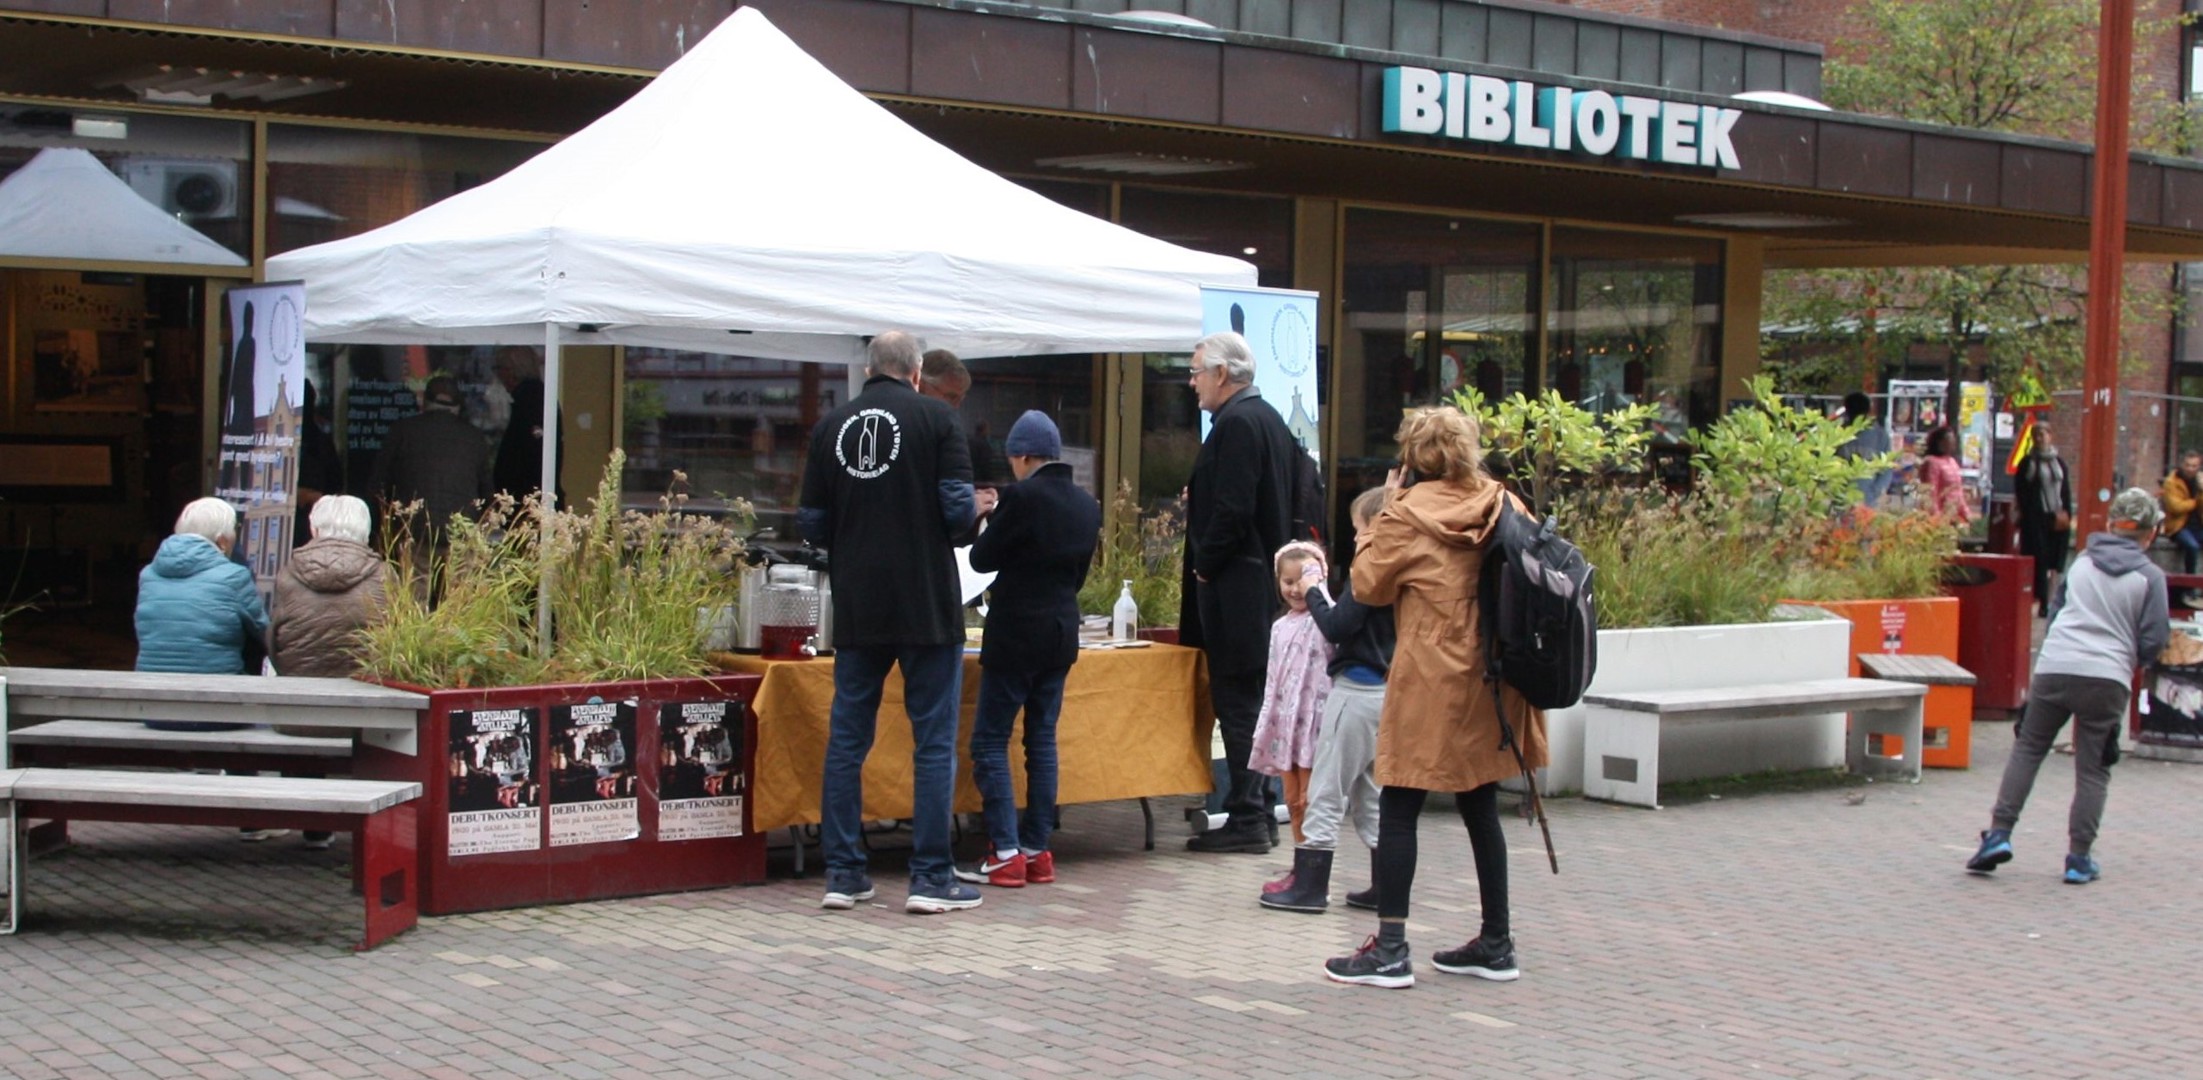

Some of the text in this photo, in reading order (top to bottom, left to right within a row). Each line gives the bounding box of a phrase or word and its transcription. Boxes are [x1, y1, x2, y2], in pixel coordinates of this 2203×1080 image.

[1383, 66, 1742, 170] BIBLIOTEK
[892, 424, 900, 432] &
[889, 431, 901, 461] TØYEN
[846, 463, 890, 479] HISTORIELAG
[552, 800, 635, 815] DEBUTKONSERT
[662, 797, 741, 811] DEBUTKONSERT
[451, 810, 539, 824] DEBUTKONSERT
[484, 823, 509, 832] GAMLA
